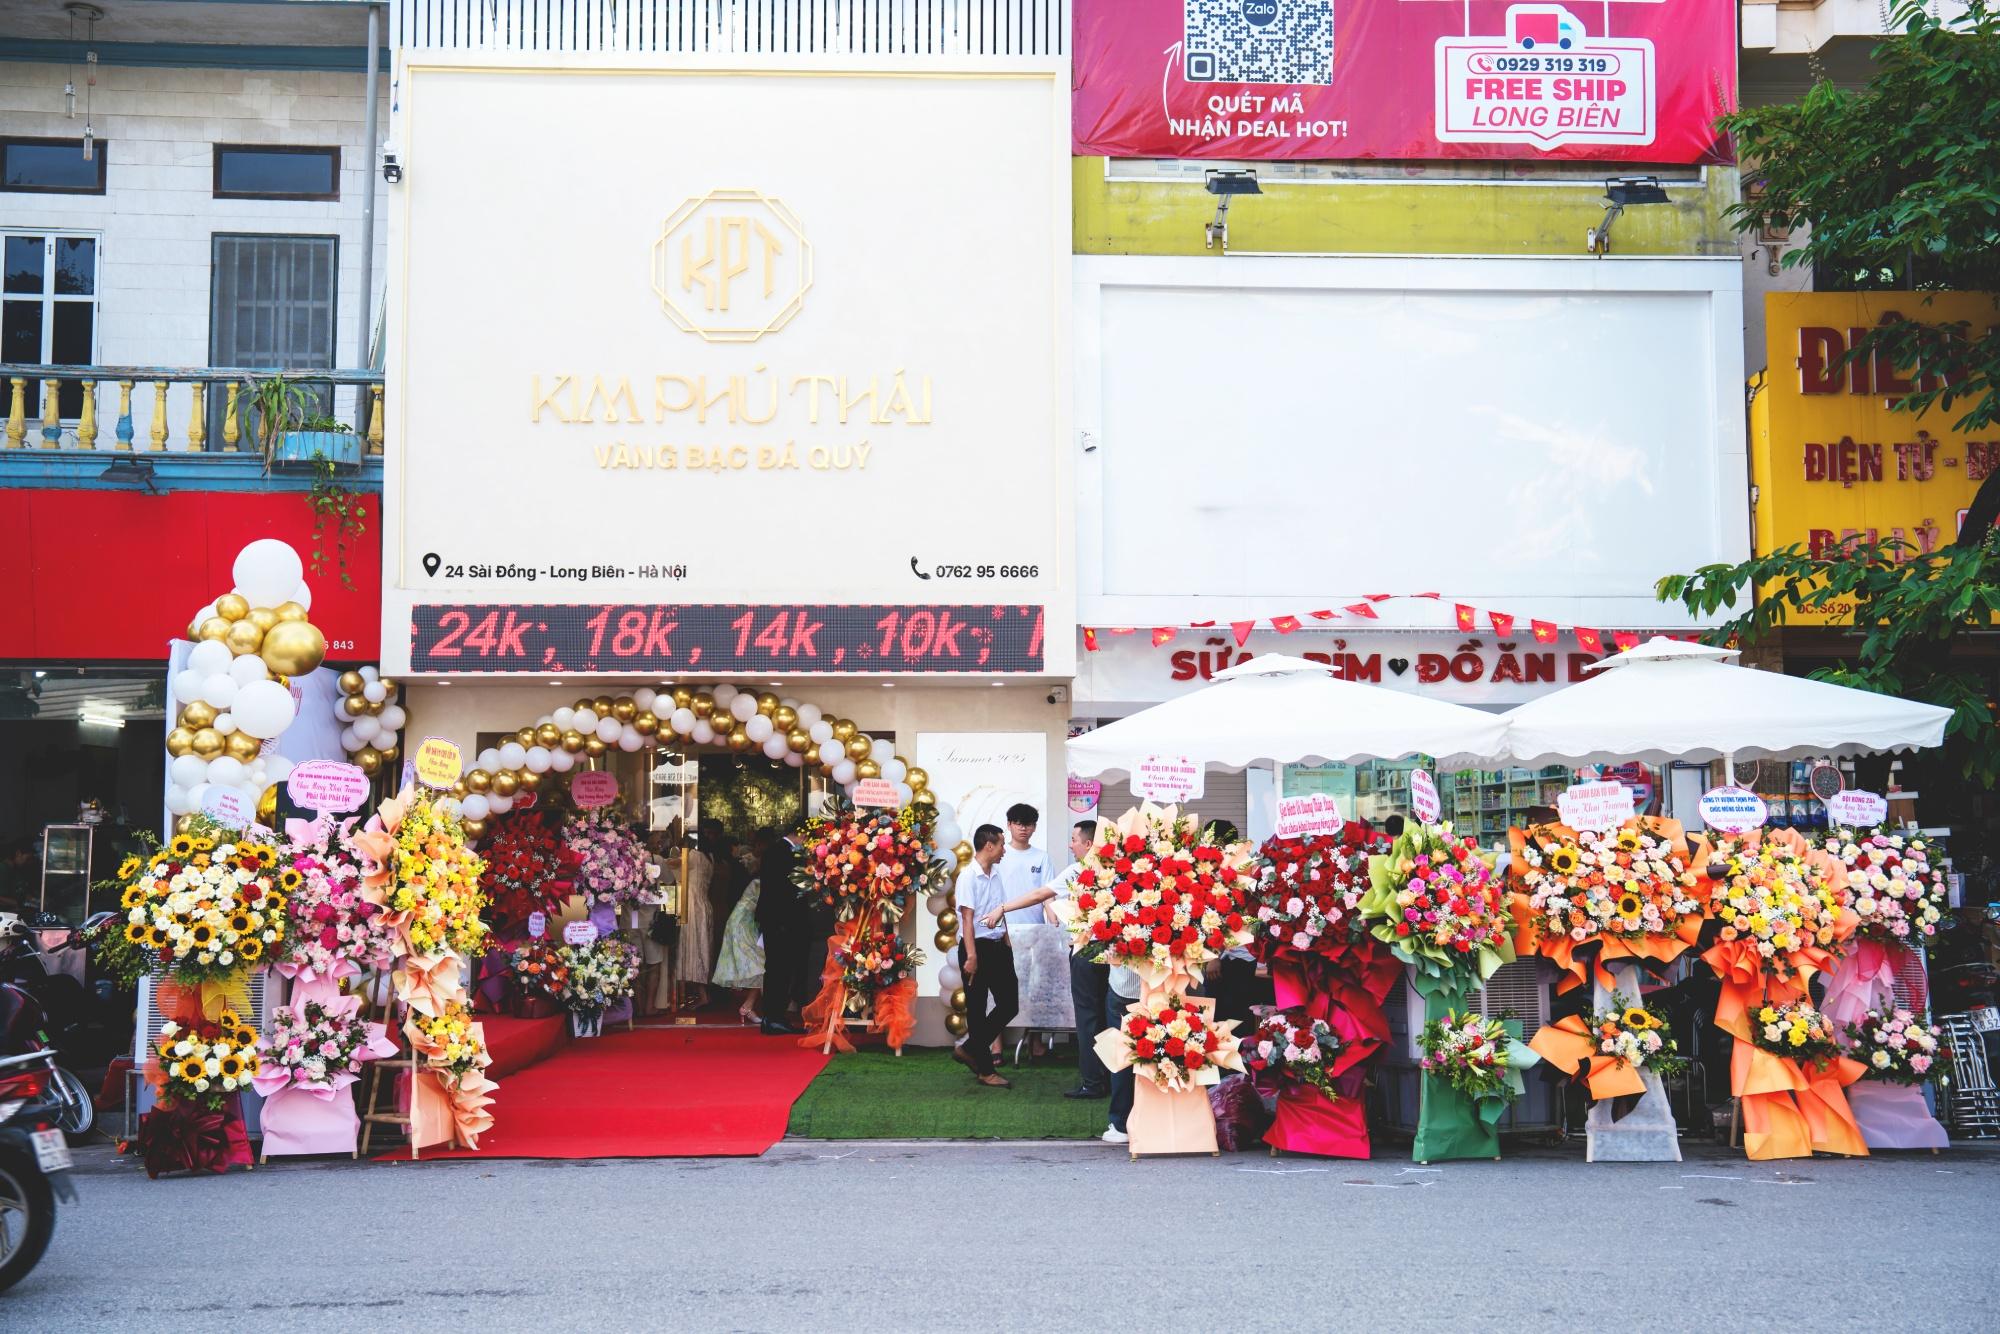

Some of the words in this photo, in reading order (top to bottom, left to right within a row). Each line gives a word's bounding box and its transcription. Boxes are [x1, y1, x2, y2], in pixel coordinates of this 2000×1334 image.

[1246, 3, 1275, 15] Zalo
[1496, 57, 1540, 72] 0929
[1544, 58, 1573, 72] 319
[1578, 58, 1607, 72] 319
[1466, 78, 1543, 100] FREE
[1552, 78, 1627, 101] SHIP
[1208, 91, 1265, 115] QUÉT
[1271, 93, 1304, 114] MÃ
[1472, 106, 1548, 127] LONG
[1557, 102, 1621, 128] BIÊN
[1169, 115, 1231, 141] NHẬN
[1237, 121, 1290, 137] DEAL
[1296, 120, 1348, 137] HOT!
[531, 373, 645, 424] KIM
[654, 362, 779, 424] PHÚ
[788, 366, 932, 425] THÁI
[594, 440, 678, 470] VÀNG
[685, 444, 748, 474] BẠC
[757, 440, 799, 470] ĐÁ
[808, 440, 873, 471] QUÝ
[1802, 436, 1883, 488] ĐIỆN
[1893, 430, 1939, 482] TỬ
[445, 565, 464, 578] 24
[468, 564, 492, 578] Sài
[495, 562, 537, 581] Đồng
[550, 564, 587, 581] Long
[591, 564, 625, 578] Biên
[638, 564, 658, 578] Hà
[662, 563, 687, 581] Nội
[936, 565, 972, 578] 0762
[976, 565, 995, 578] 95
[1000, 565, 1039, 578] 6666
[333, 640, 354, 650] 843
[1415, 638, 1484, 683] ĐỒ
[1490, 642, 1556, 683] ĂN
[1568, 643, 1619, 682] D
[936, 746, 992, 763] Summer
